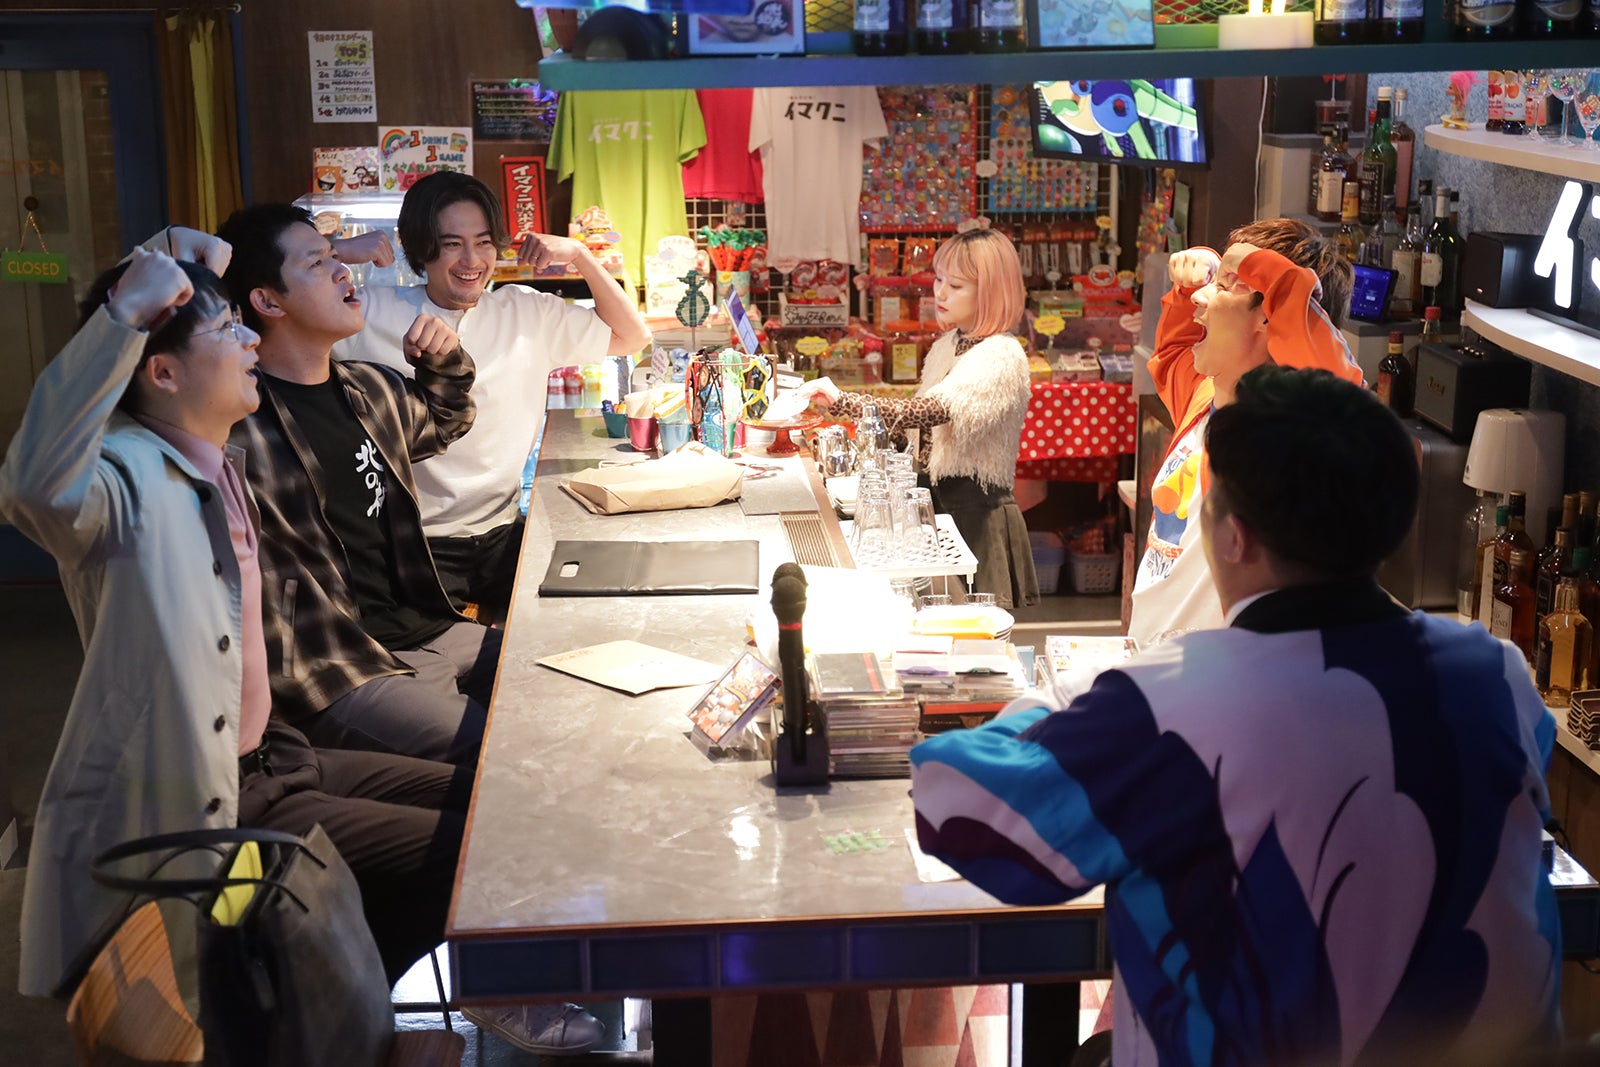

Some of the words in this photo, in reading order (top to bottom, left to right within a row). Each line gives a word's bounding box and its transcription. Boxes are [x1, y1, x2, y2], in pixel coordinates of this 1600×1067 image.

[784, 101, 846, 123] イマクニ
[422, 136, 449, 145] DRINK
[588, 121, 655, 144] イマクニ
[439, 153, 464, 162] GAME
[7, 260, 60, 276] CLOSED
